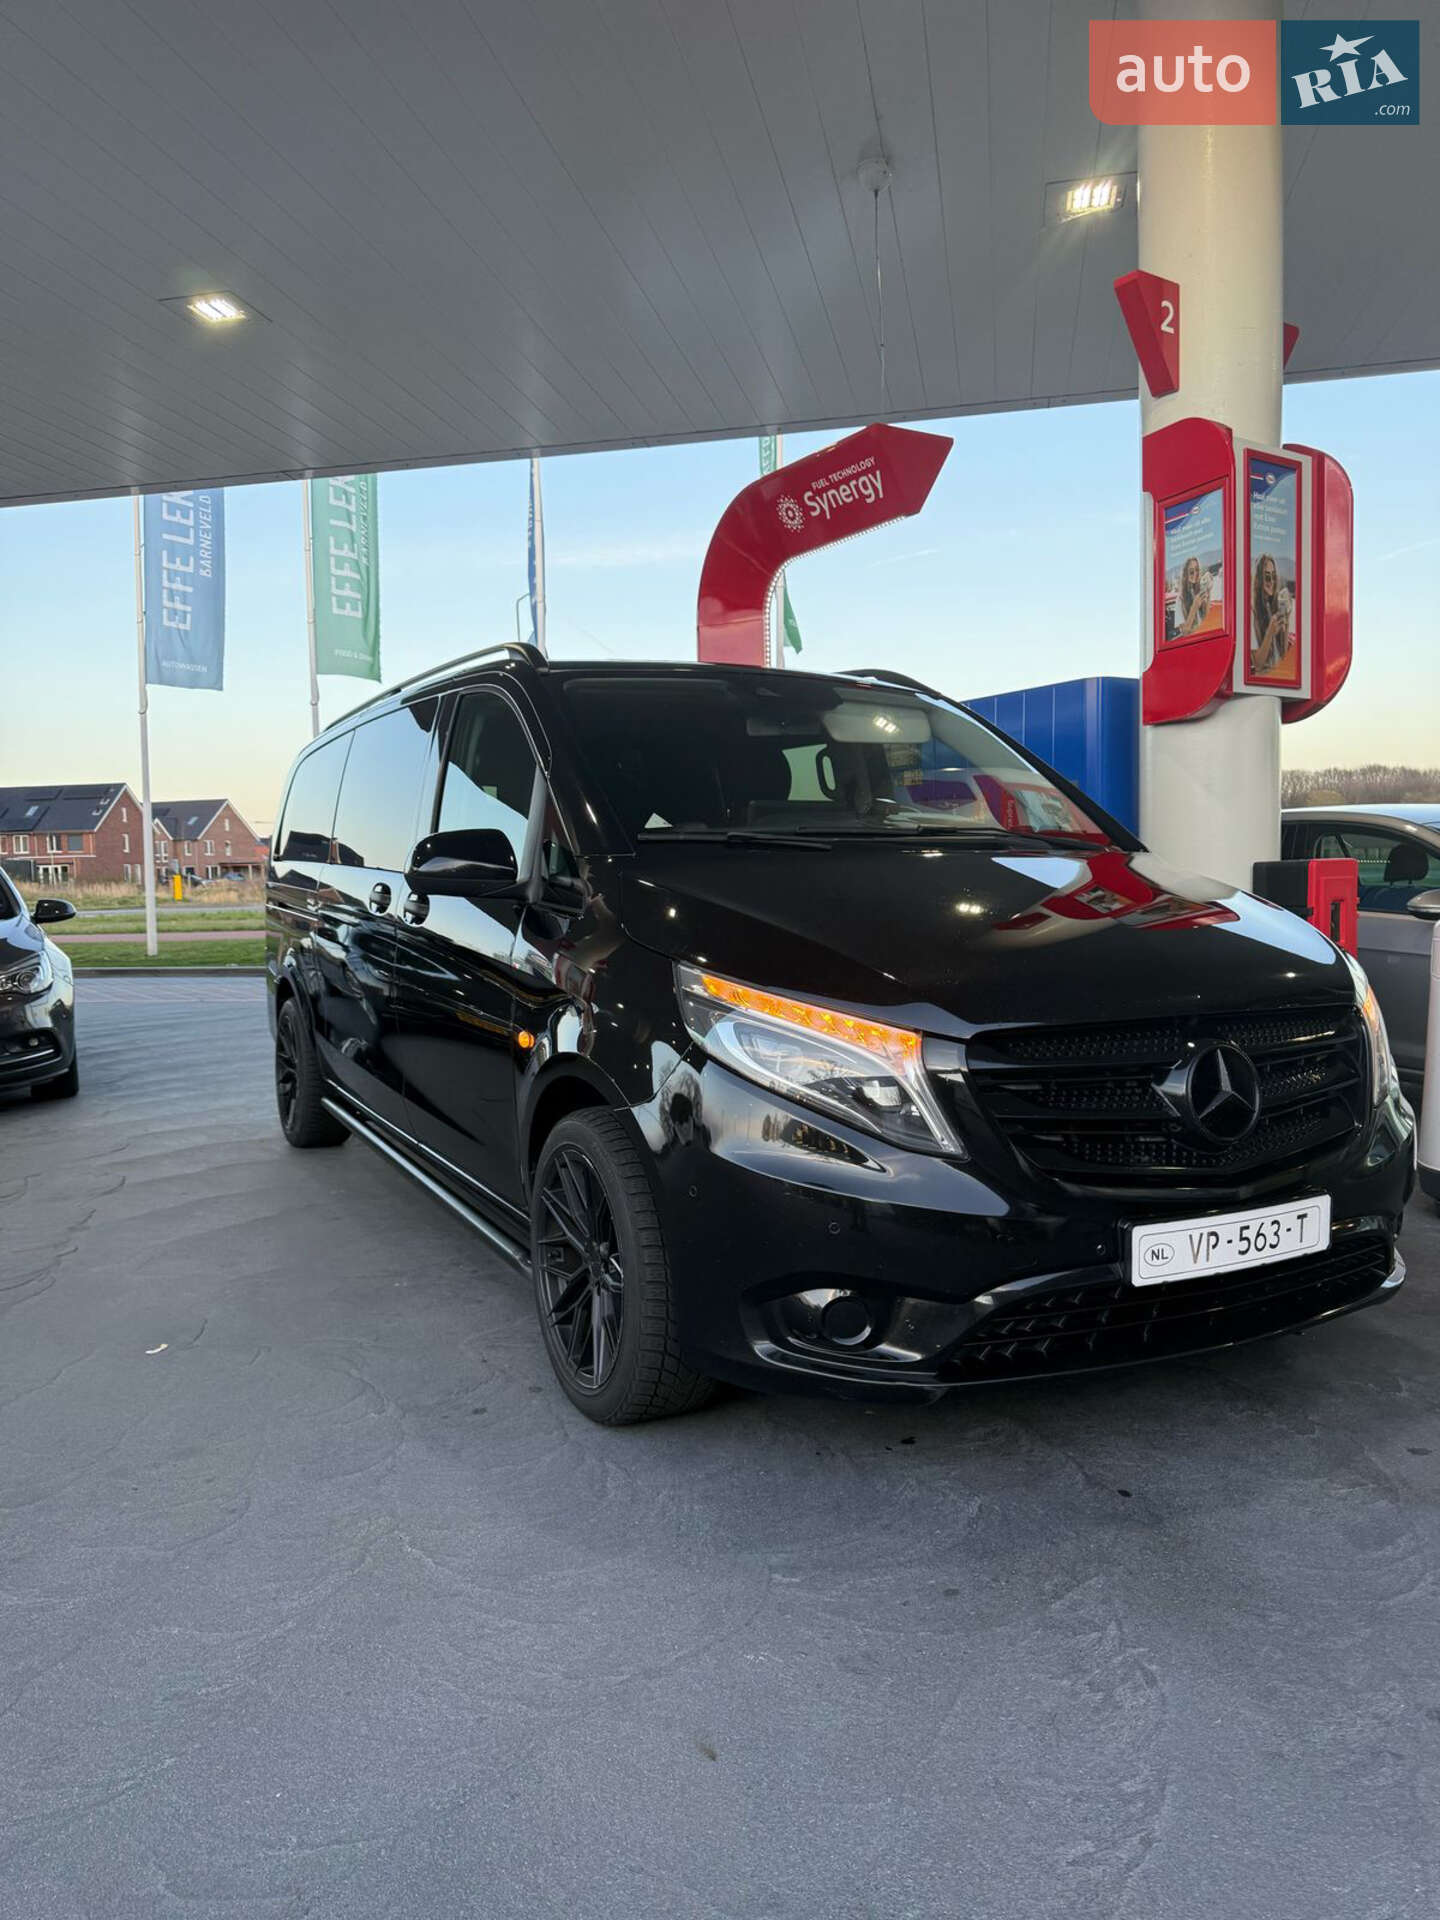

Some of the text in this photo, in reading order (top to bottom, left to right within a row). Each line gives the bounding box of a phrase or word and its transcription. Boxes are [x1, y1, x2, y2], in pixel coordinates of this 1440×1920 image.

[1160, 300, 1175, 334] 2
[803, 469, 884, 520] Synergy
[811, 456, 876, 491] FUEL TECHNOLOGY
[199, 495, 212, 578] BARNEVELD
[161, 550, 194, 631] EFFE
[329, 535, 364, 619] EFFE
[1150, 1248, 1169, 1261] NL
[1189, 1212, 1308, 1265] VP-563-T
